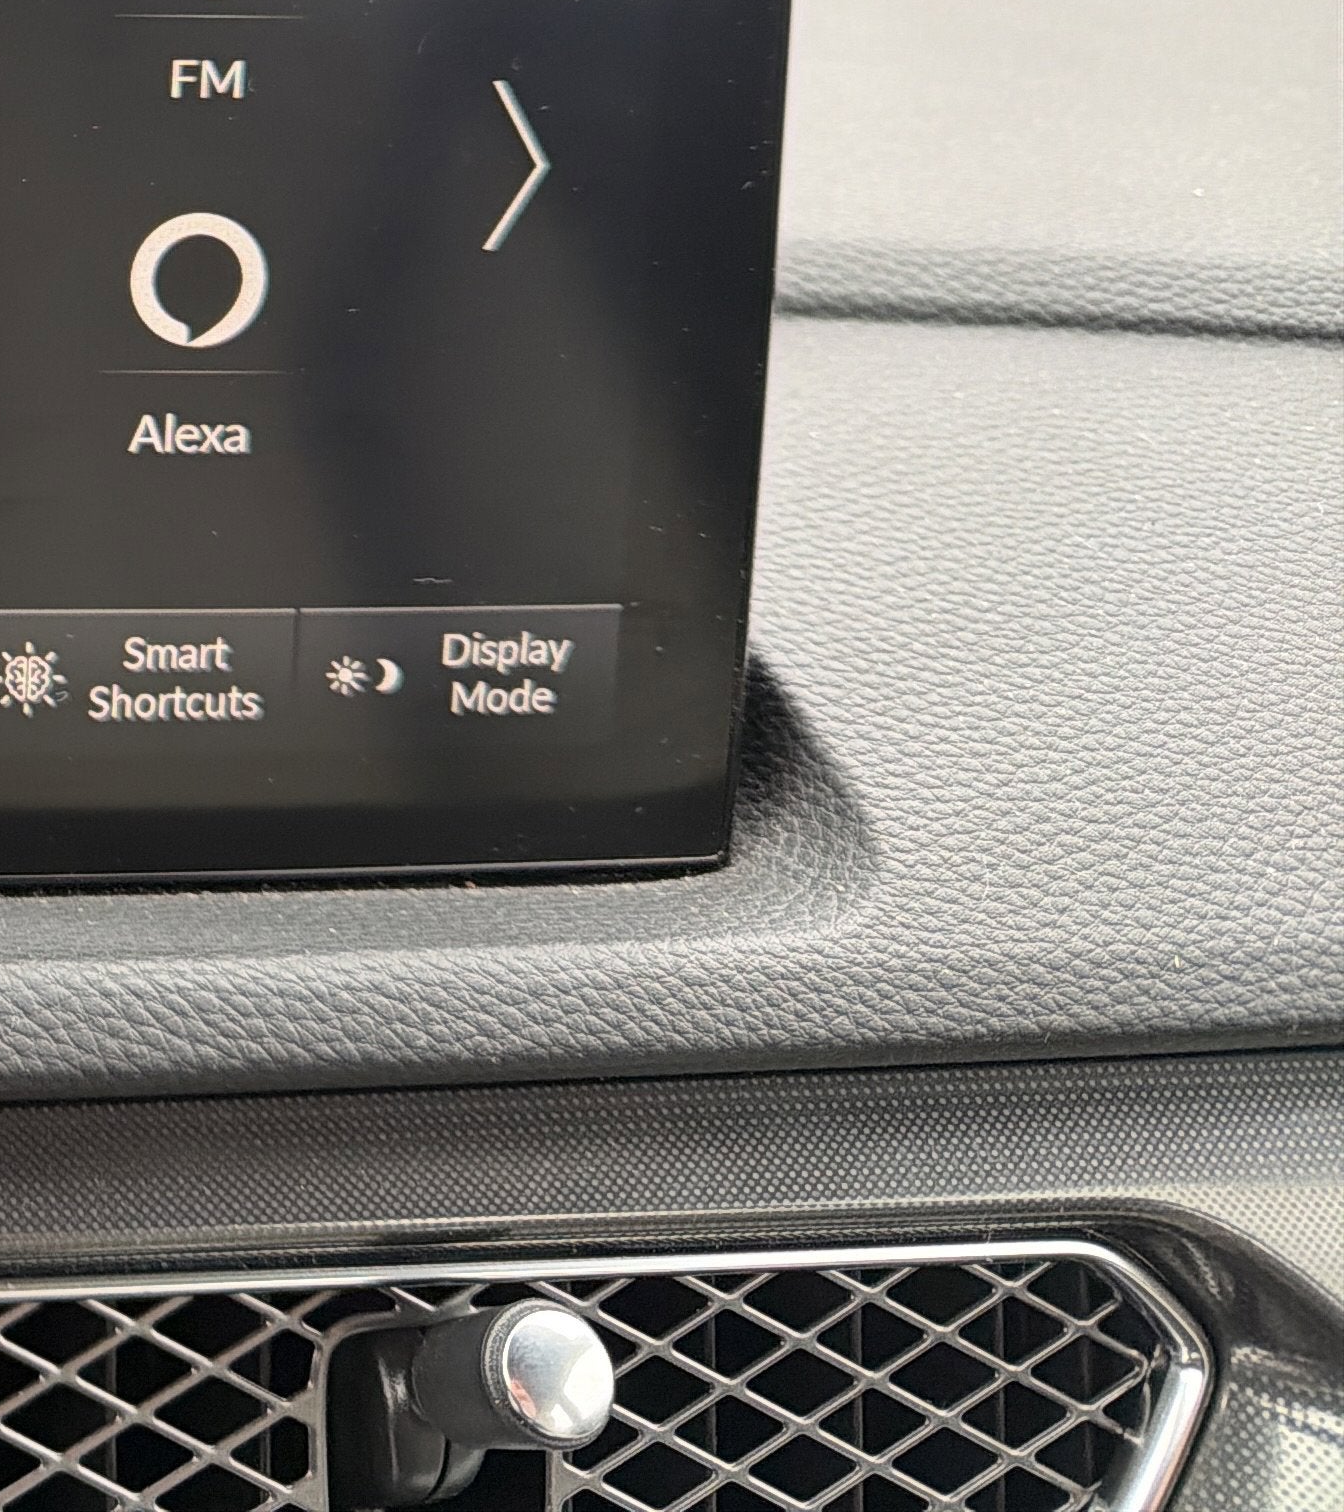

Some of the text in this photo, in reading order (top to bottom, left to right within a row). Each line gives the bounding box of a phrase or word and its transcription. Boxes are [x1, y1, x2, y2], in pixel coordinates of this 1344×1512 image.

[170, 59, 246, 99] FM
[127, 412, 250, 454] Alexa
[122, 636, 231, 672] Smart
[442, 630, 573, 674] Display
[87, 683, 263, 721] Shortcuts
[450, 678, 556, 715] Mode
